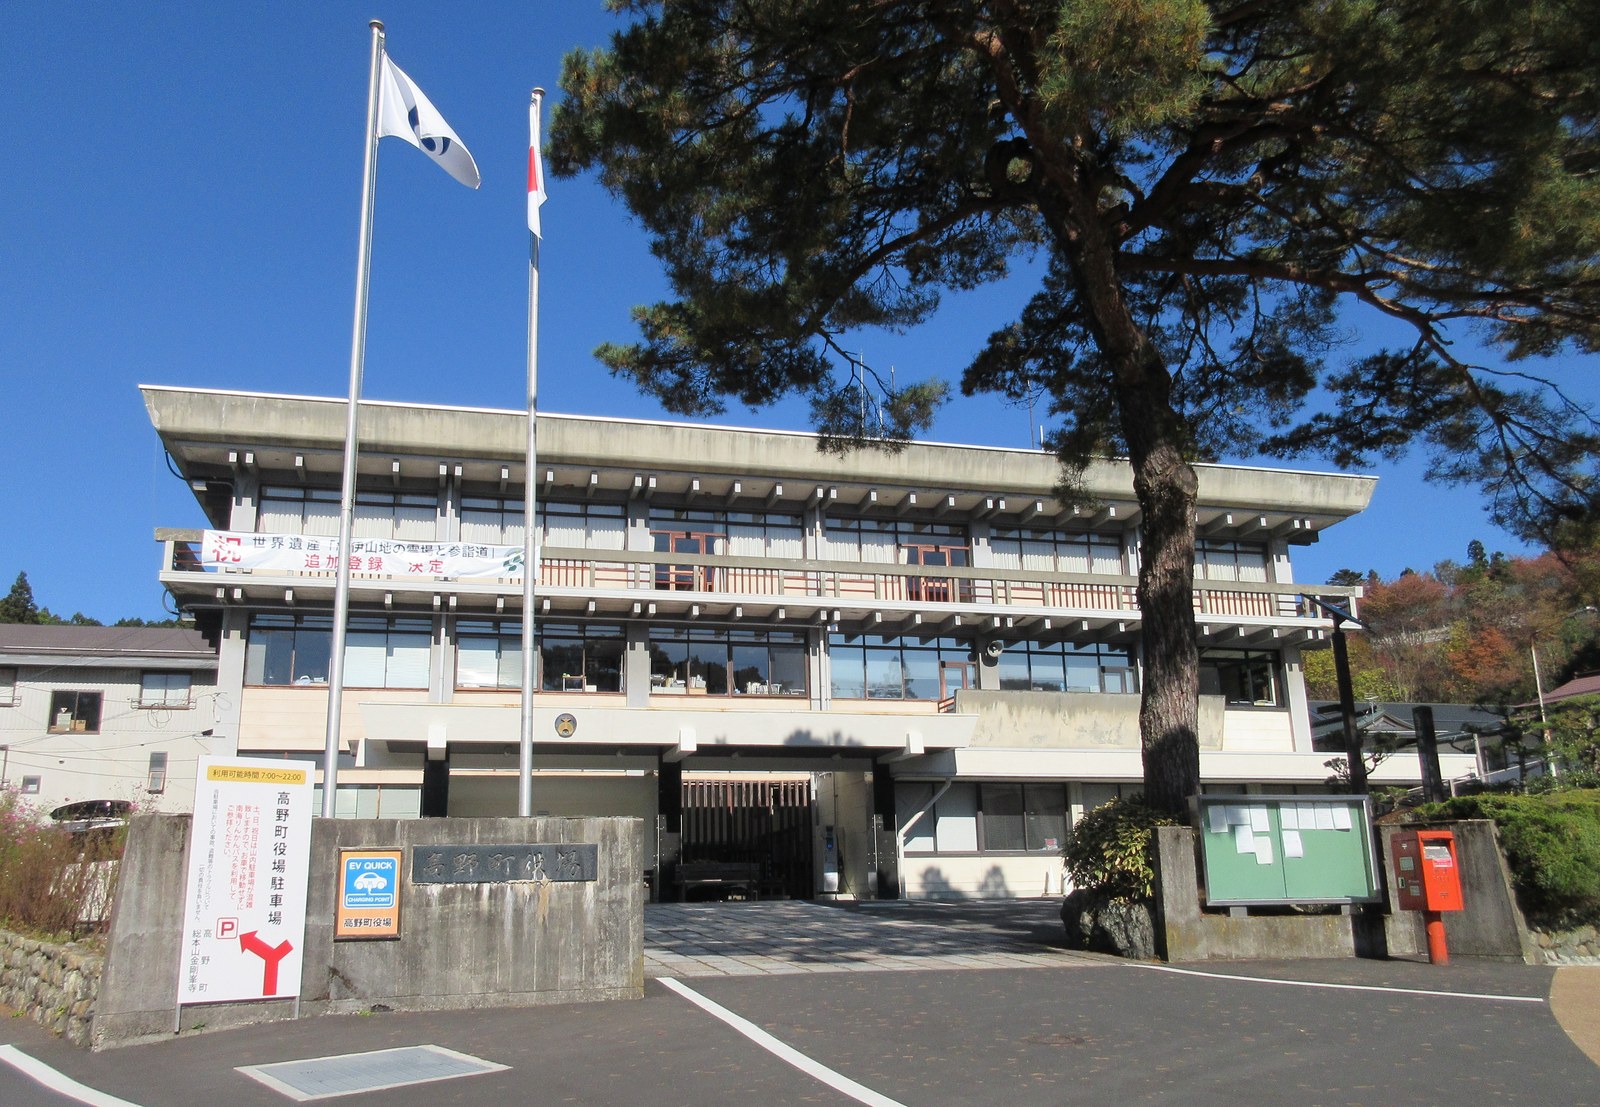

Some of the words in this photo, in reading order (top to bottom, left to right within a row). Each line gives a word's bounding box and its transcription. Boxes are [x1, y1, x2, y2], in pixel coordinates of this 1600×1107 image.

[304, 553, 383, 571] 追加登録
[408, 559, 443, 574] 決定
[212, 769, 260, 779] 利用可能時間
[229, 805, 243, 900] 南海りんかんバスを利用して
[267, 791, 291, 926] 高野町役場駐車場
[349, 862, 361, 870] EV
[363, 862, 392, 870] QUICK
[422, 850, 581, 880] 高野町役場
[221, 921, 234, 936] P
[343, 918, 392, 928] 高野町役場
[188, 929, 202, 993] 総本山金剛峯寺
